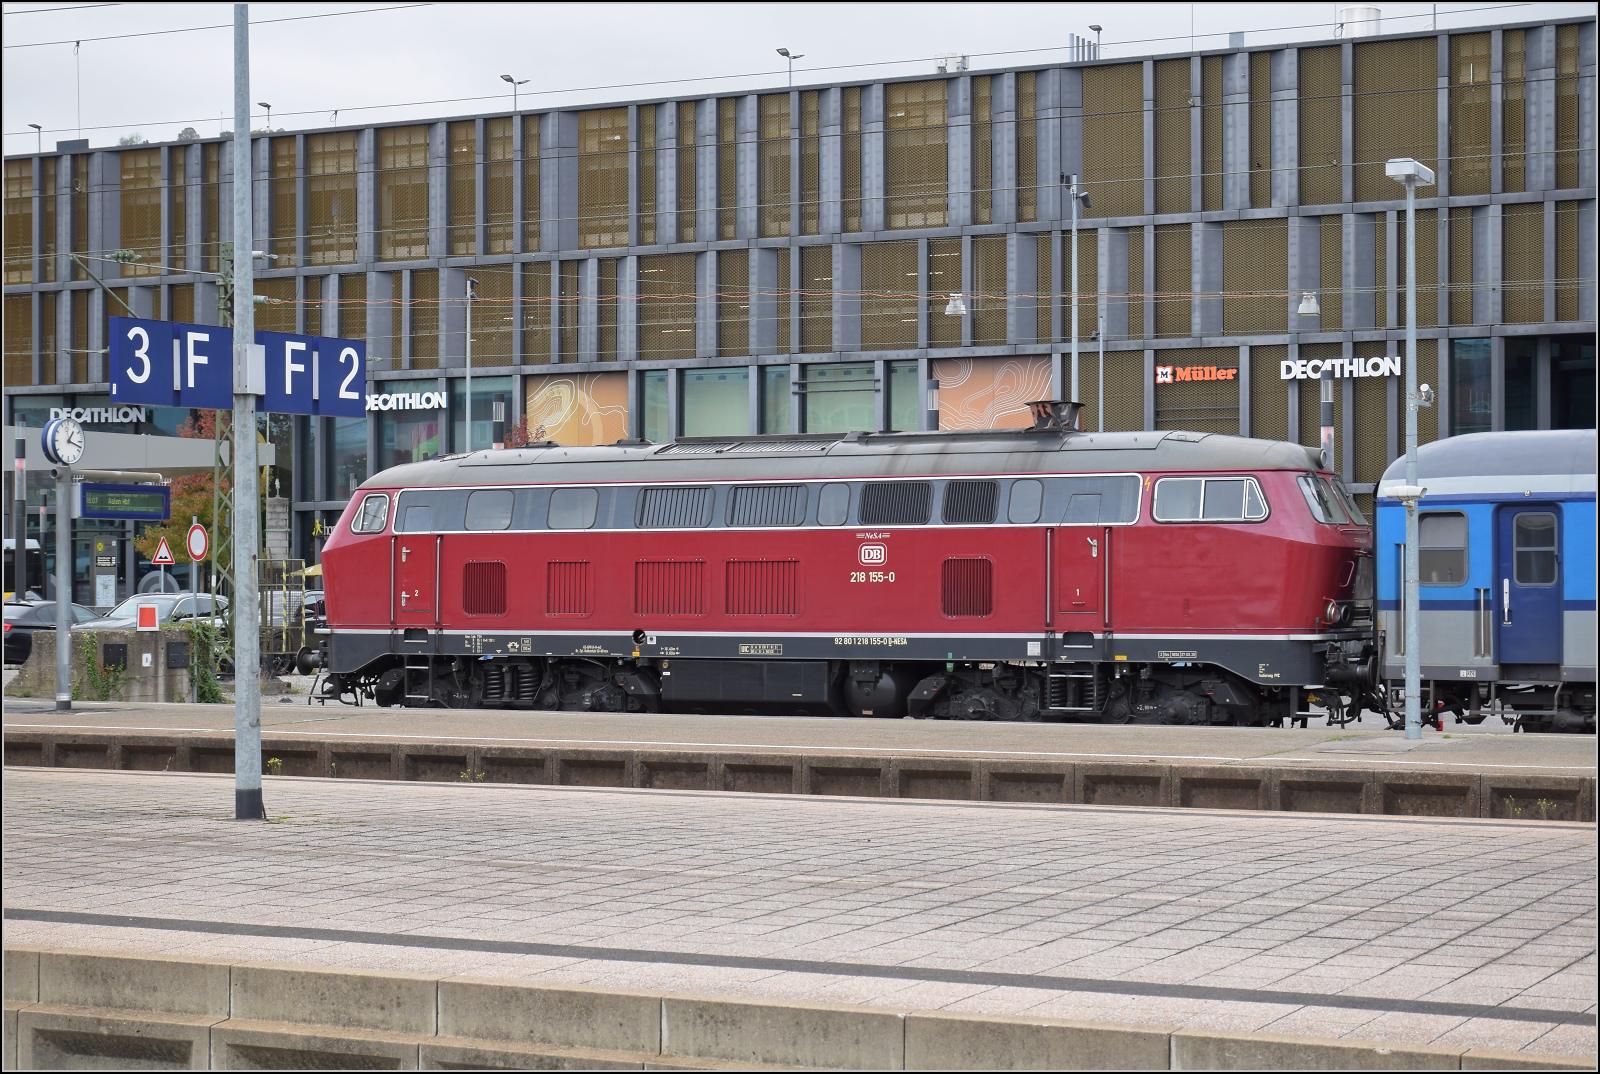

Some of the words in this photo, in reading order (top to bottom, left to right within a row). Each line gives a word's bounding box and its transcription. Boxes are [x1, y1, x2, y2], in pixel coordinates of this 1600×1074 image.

[126, 326, 151, 384] 3
[187, 331, 210, 388] F
[285, 340, 306, 395] F
[338, 346, 360, 400] 2
[1175, 366, 1237, 382] Müller
[1280, 356, 1401, 380] DECATHLON
[49, 406, 146, 423] DECATHLON
[864, 549, 881, 560] DB
[850, 571, 866, 583] 218
[868, 571, 895, 583] 155-0
[414, 589, 419, 597] 2
[1076, 588, 1080, 597] 1
[834, 637, 843, 645] 92
[843, 637, 852, 645] 80
[857, 637, 869, 645] 218
[870, 637, 888, 645] 155-0
